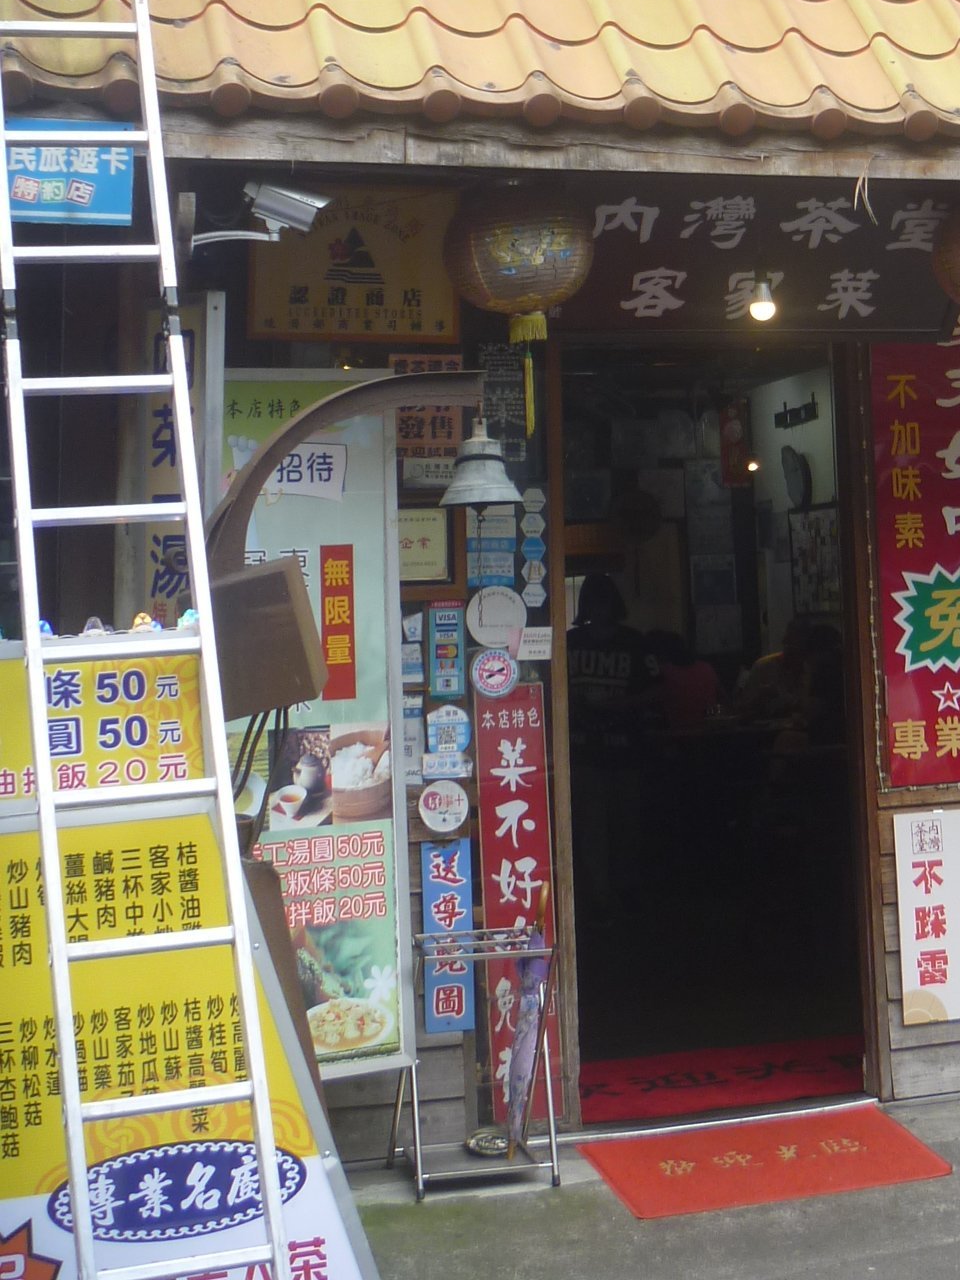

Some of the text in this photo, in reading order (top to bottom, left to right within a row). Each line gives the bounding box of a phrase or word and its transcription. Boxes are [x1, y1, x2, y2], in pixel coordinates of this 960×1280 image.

[13, 177, 94, 204] 特約店
[593, 196, 945, 252] 內灣茶堂
[620, 267, 880, 319] 客家菜
[277, 452, 333, 484] 招待
[886, 374, 926, 549] 不加味素
[324, 558, 352, 664] 無限量
[482, 708, 540, 730] 本店特色
[7, 859, 32, 967] 炒山豬肉
[93, 850, 117, 929] 鹹豬肉
[284, 892, 386, 928] 拌飯20元
[912, 859, 948, 986] 不踩雷
[19, 1017, 42, 1127] 炒柳松菇
[90, 1009, 112, 1089] 炒山藥
[160, 1000, 182, 1081] 炒山蘇
[206, 995, 228, 1074] 炒桂筍
[0, 1021, 20, 1159] 三杯杏鮑菇
